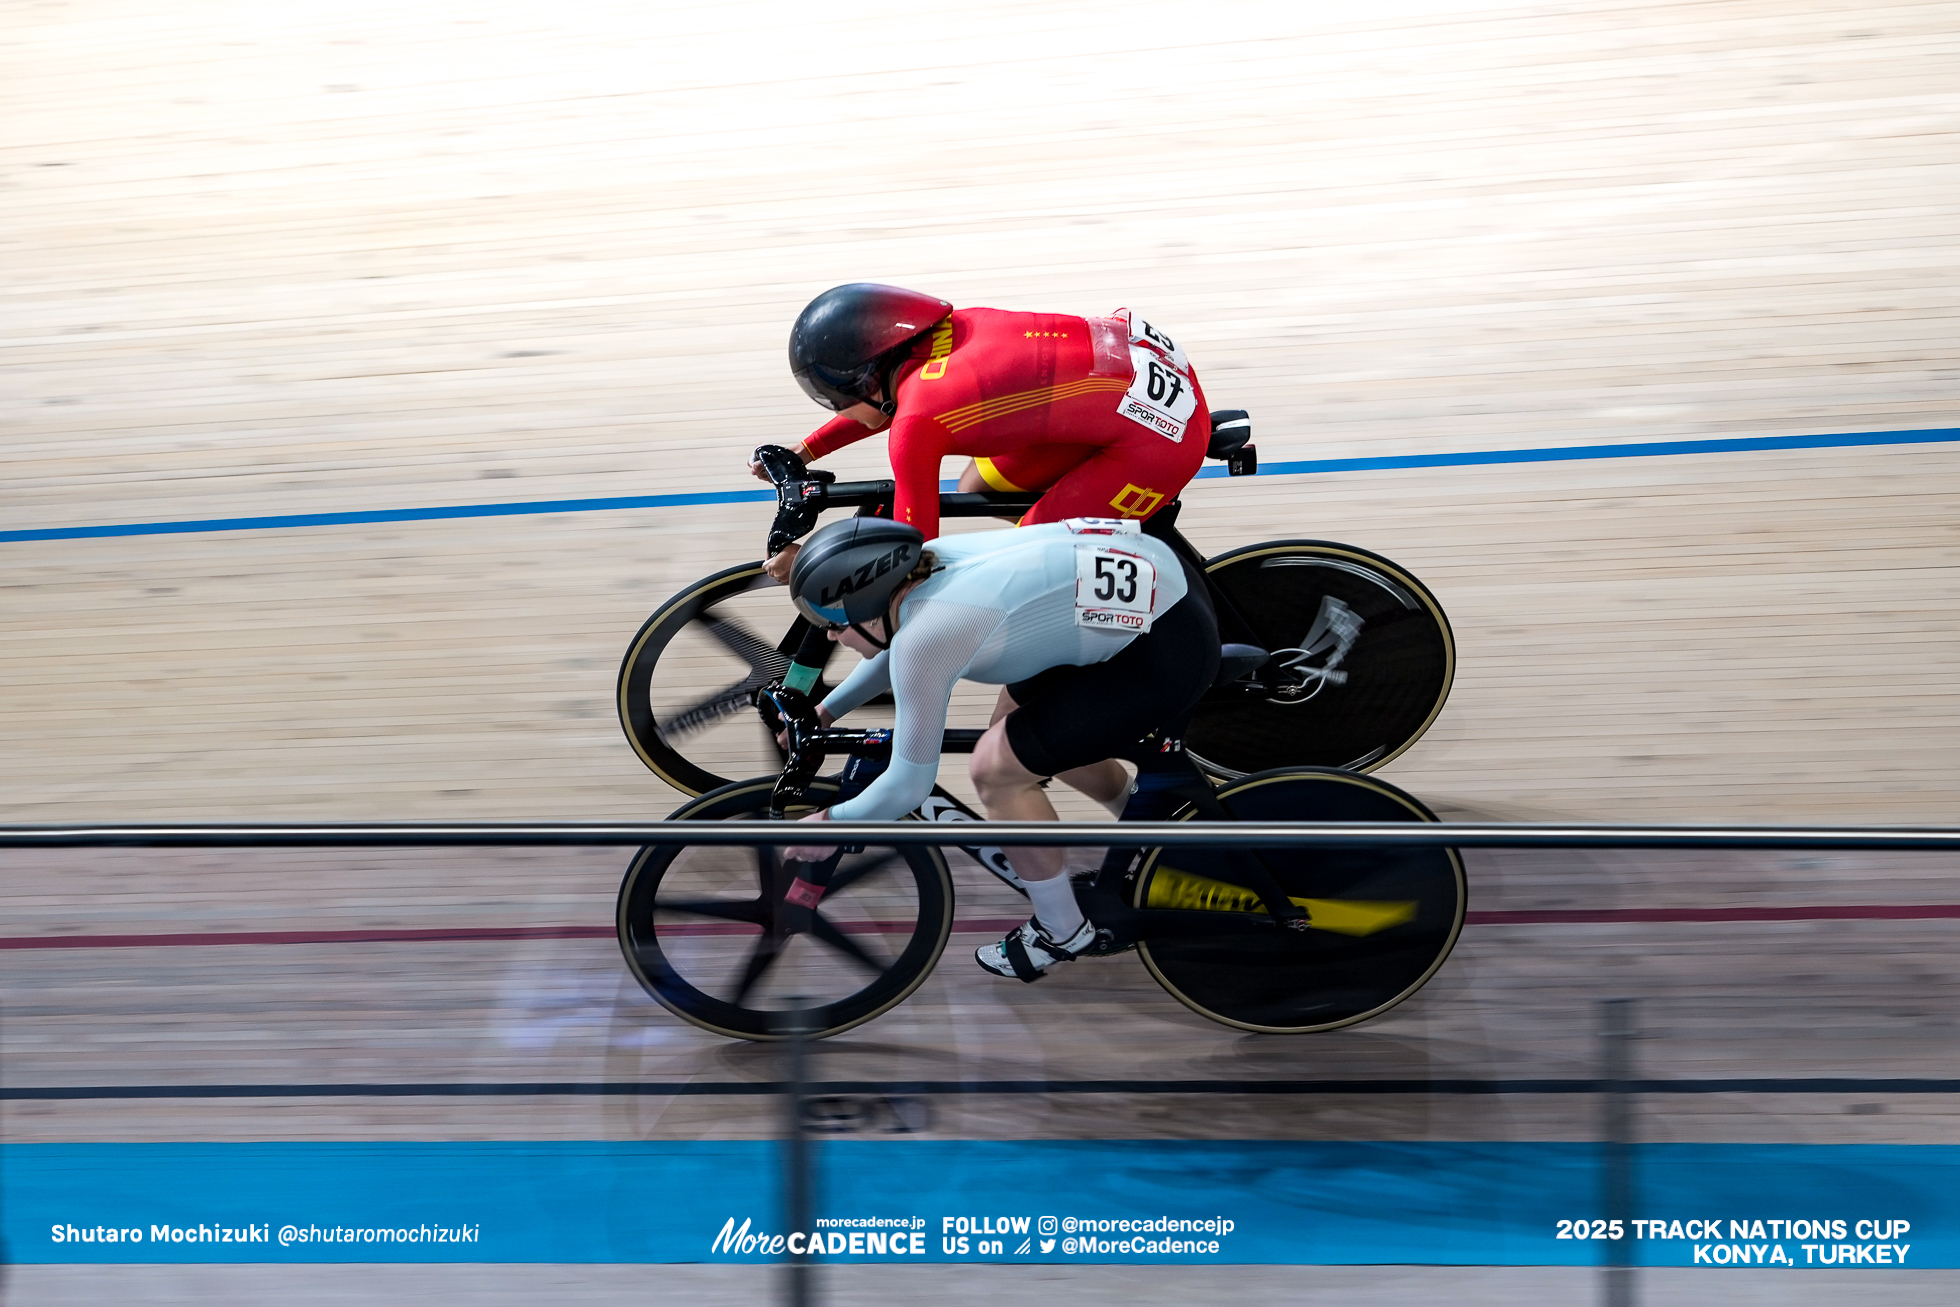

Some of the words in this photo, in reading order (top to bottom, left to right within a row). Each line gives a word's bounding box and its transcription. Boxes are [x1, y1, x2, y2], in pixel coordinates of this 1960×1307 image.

[1147, 361, 1184, 408] 67
[820, 544, 911, 606] LAZER
[1095, 556, 1138, 603] 53
